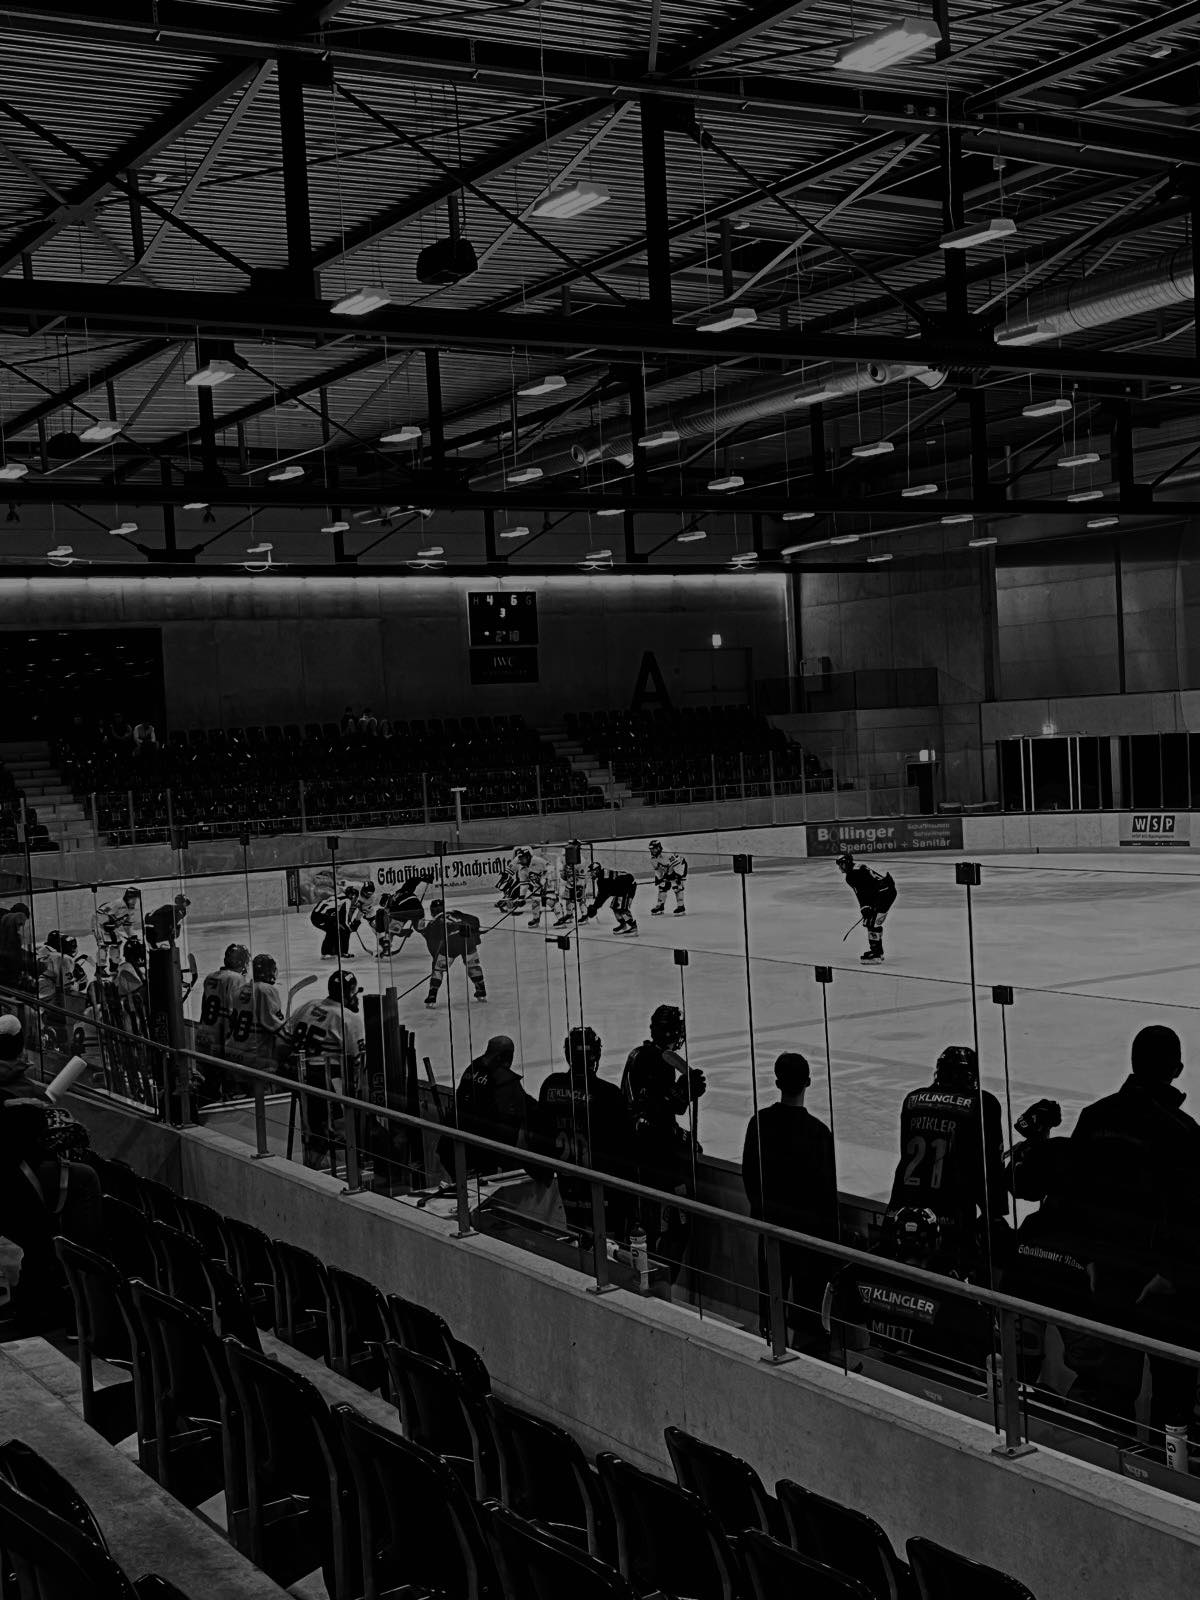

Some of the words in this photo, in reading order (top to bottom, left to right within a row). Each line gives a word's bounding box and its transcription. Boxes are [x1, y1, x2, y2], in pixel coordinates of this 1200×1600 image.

[486, 594, 494, 606] 4
[510, 594, 518, 606] 6
[1134, 817, 1173, 831] WSP
[377, 863, 450, 886] Schaffhausr
[452, 857, 511, 878] Nachricht
[918, 1093, 972, 1108] KLINGLER
[904, 1136, 947, 1189] 21
[873, 1288, 935, 1315] KLINGLER
